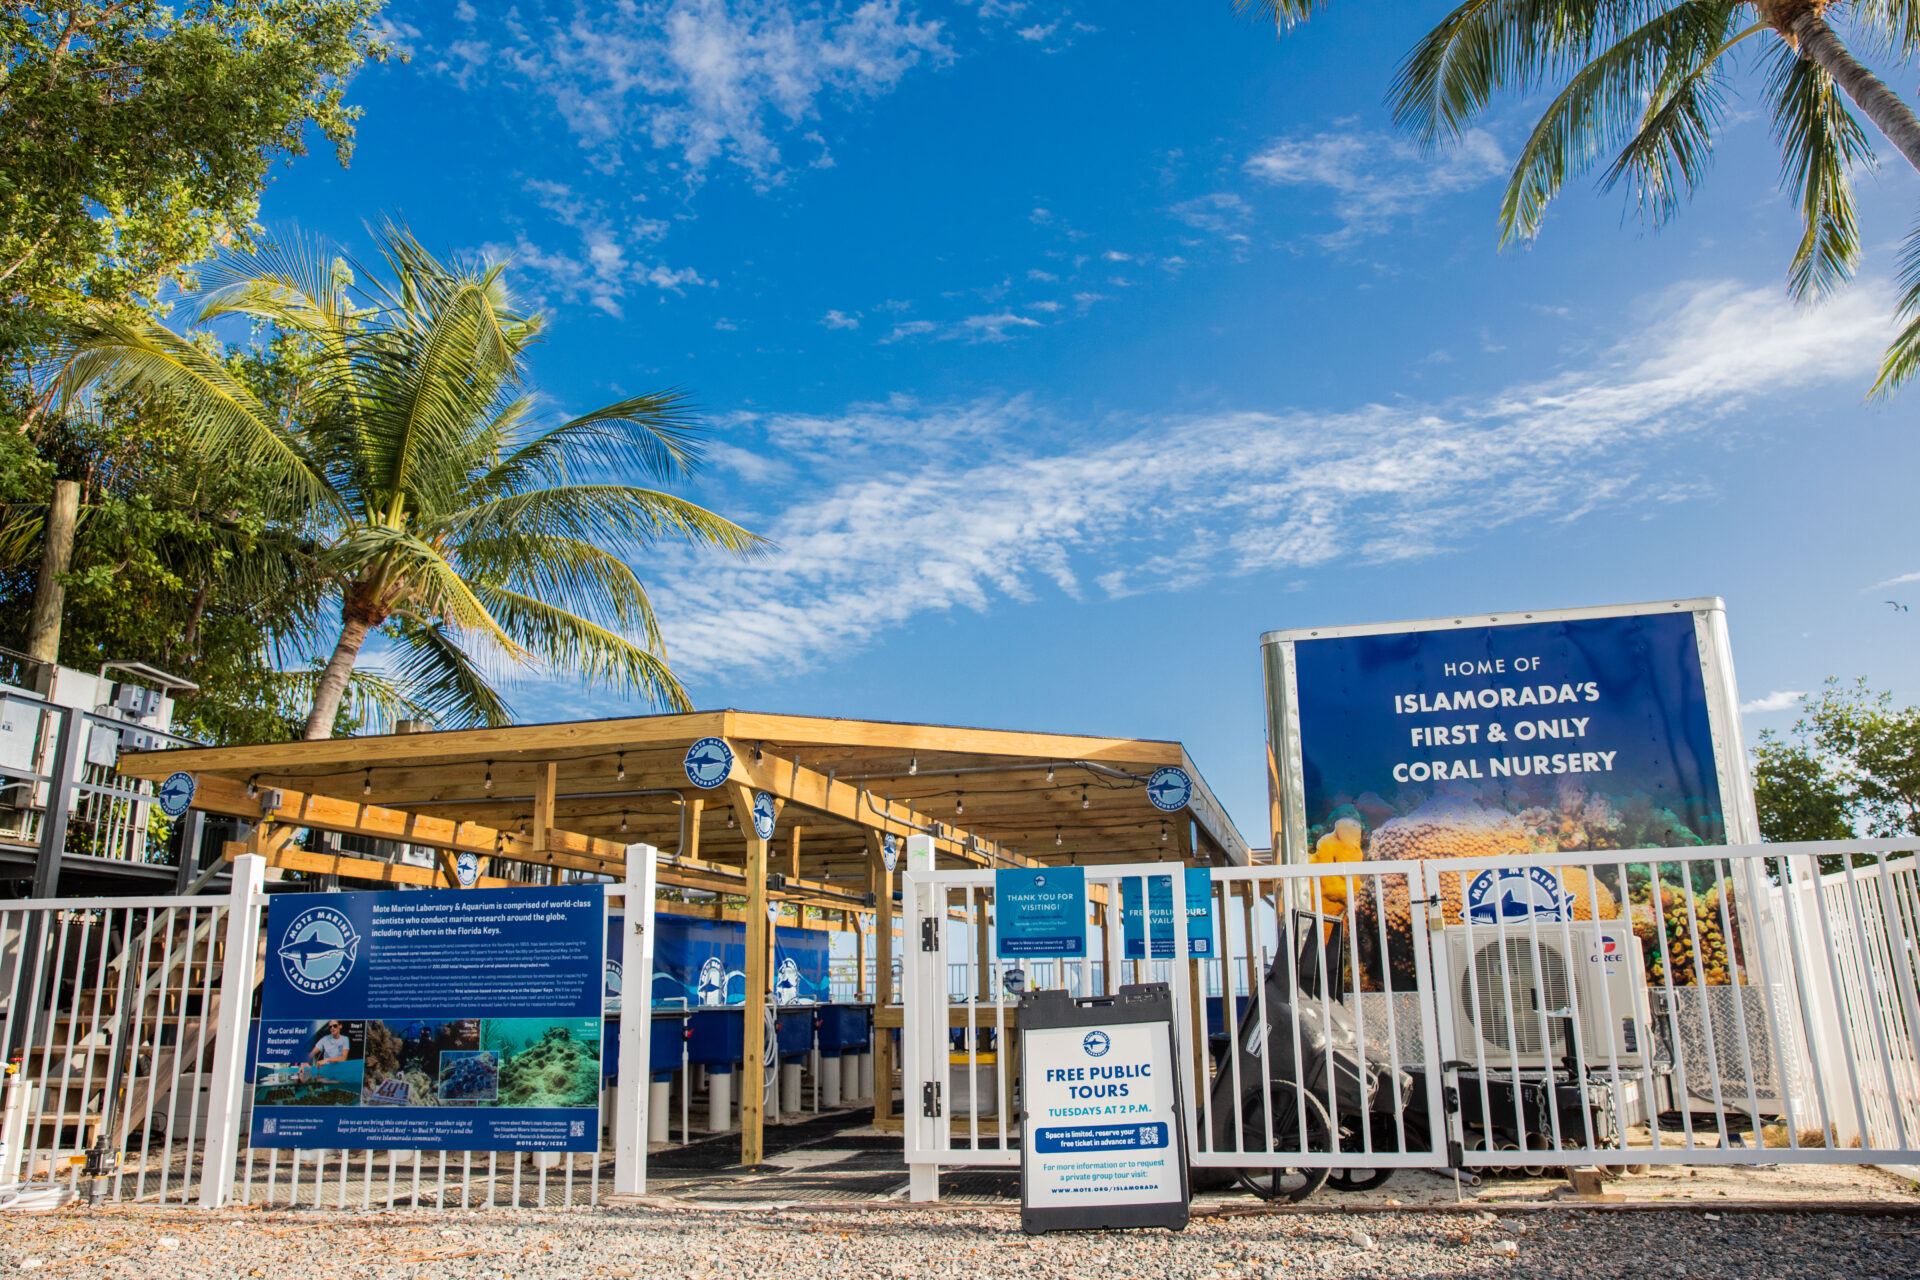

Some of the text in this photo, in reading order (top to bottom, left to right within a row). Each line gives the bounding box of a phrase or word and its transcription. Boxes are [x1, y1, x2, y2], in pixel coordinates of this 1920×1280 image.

[1444, 656, 1540, 676] HOME OF
[1411, 717, 1590, 747] FIRST & ONLY
[691, 740, 729, 756] MOTE MARINE
[1393, 751, 1617, 782] CORAL NURSERY
[690, 772, 726, 786] LABORATORY
[416, 904, 453, 912] Laboratory
[461, 902, 495, 912] Aquarium
[503, 901, 540, 910] comprised
[550, 900, 591, 908] world-class
[289, 912, 350, 939] MOTE MARINE
[372, 917, 404, 925] scientists
[421, 916, 448, 924] conduct
[507, 913, 531, 921] around
[546, 913, 567, 922] globe,
[372, 929, 401, 938] including
[403, 928, 419, 938] right
[458, 927, 481, 935] Florida
[483, 927, 502, 936] Keys.
[289, 965, 346, 989] LABORATORY
[1046, 1064, 1151, 1082] FREE PUBLIC
[1069, 1084, 1129, 1099] TOURS
[1048, 1104, 1152, 1117] TUESDAYS AT 2 P.M.
[1045, 1131, 1064, 1140] Space
[1071, 1130, 1094, 1138] limited,
[1076, 1161, 1117, 1170] information
[1137, 1160, 1164, 1169] request
[1066, 1173, 1090, 1182] private
[1052, 1185, 1158, 1193] WWW.MOTE.ORG/ISLAMORADA
